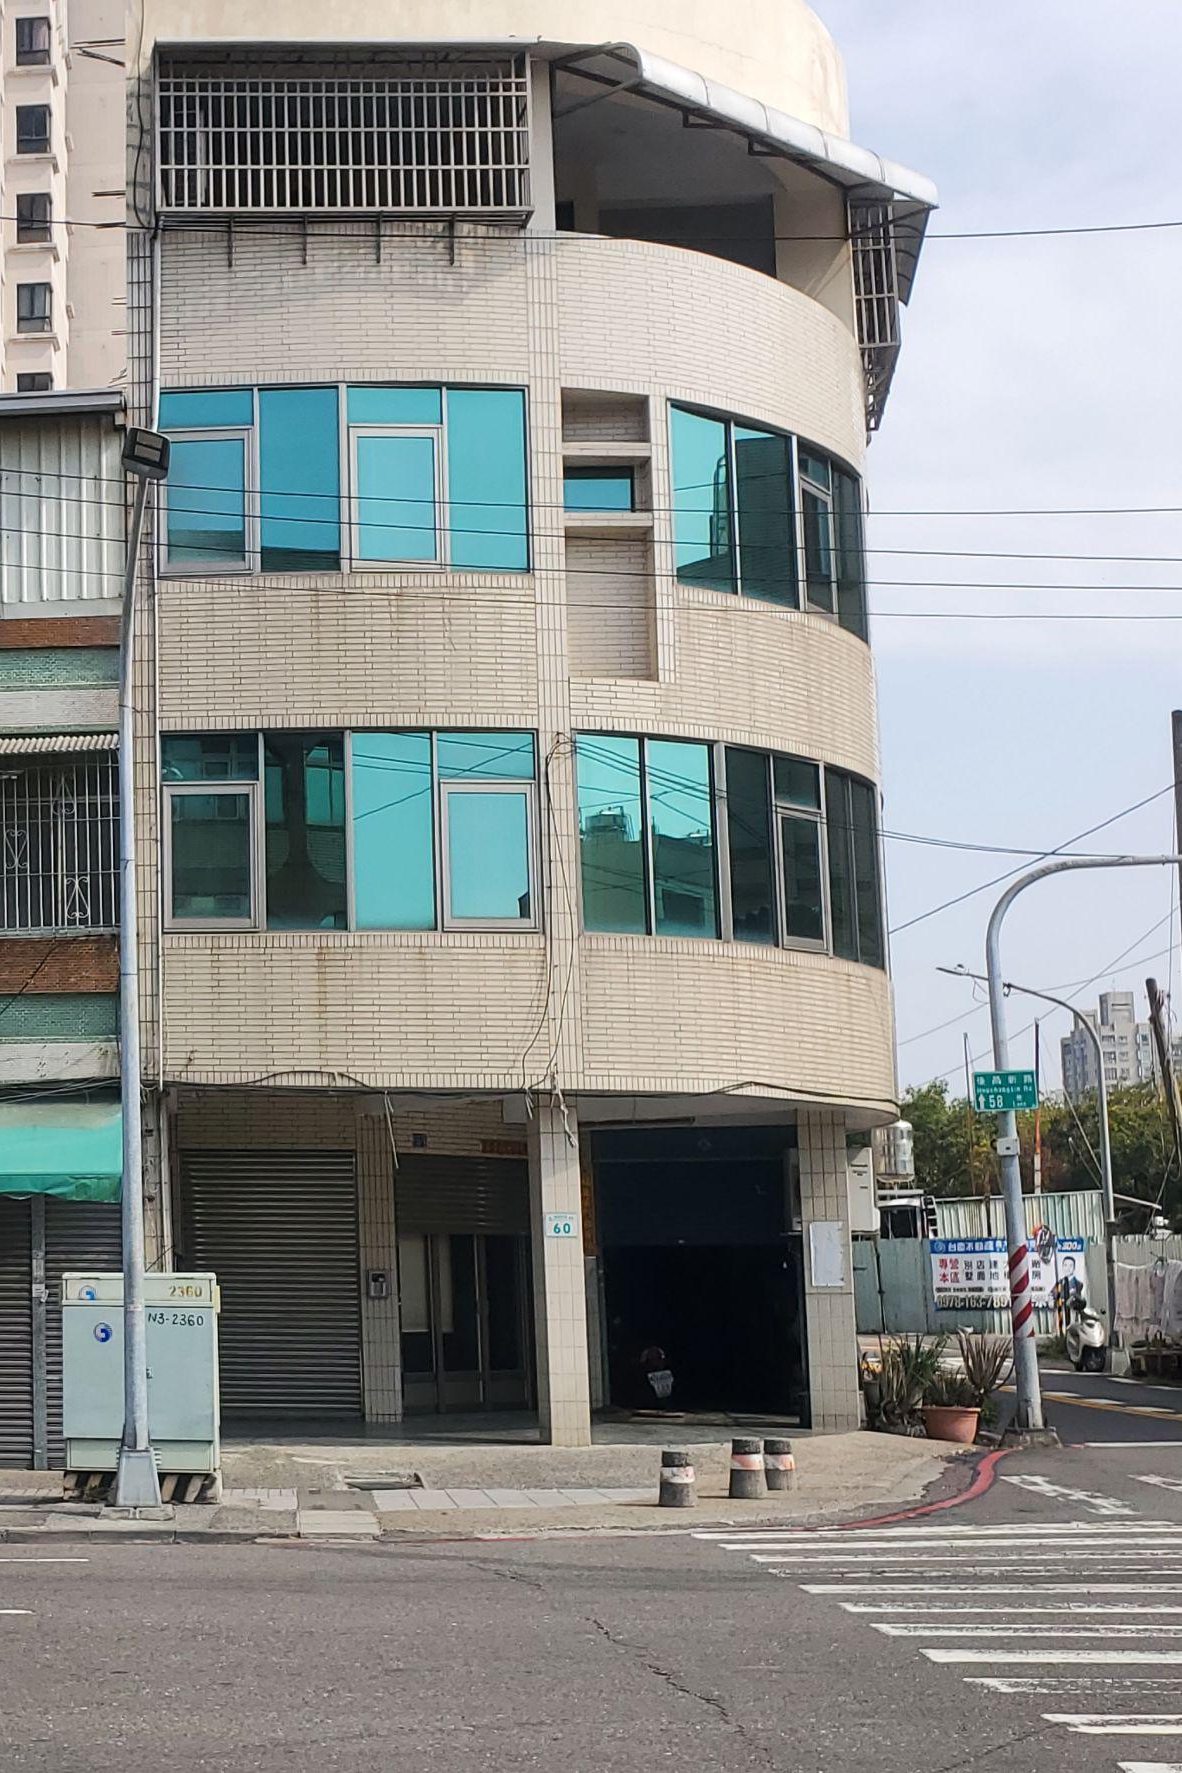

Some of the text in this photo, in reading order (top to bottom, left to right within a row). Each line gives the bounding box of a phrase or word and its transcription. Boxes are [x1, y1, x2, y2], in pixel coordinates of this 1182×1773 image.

[988, 1094, 1004, 1109] 58
[553, 1222, 571, 1234] 60
[168, 1285, 203, 1298] 2360
[147, 1312, 204, 1327] N3-2360
